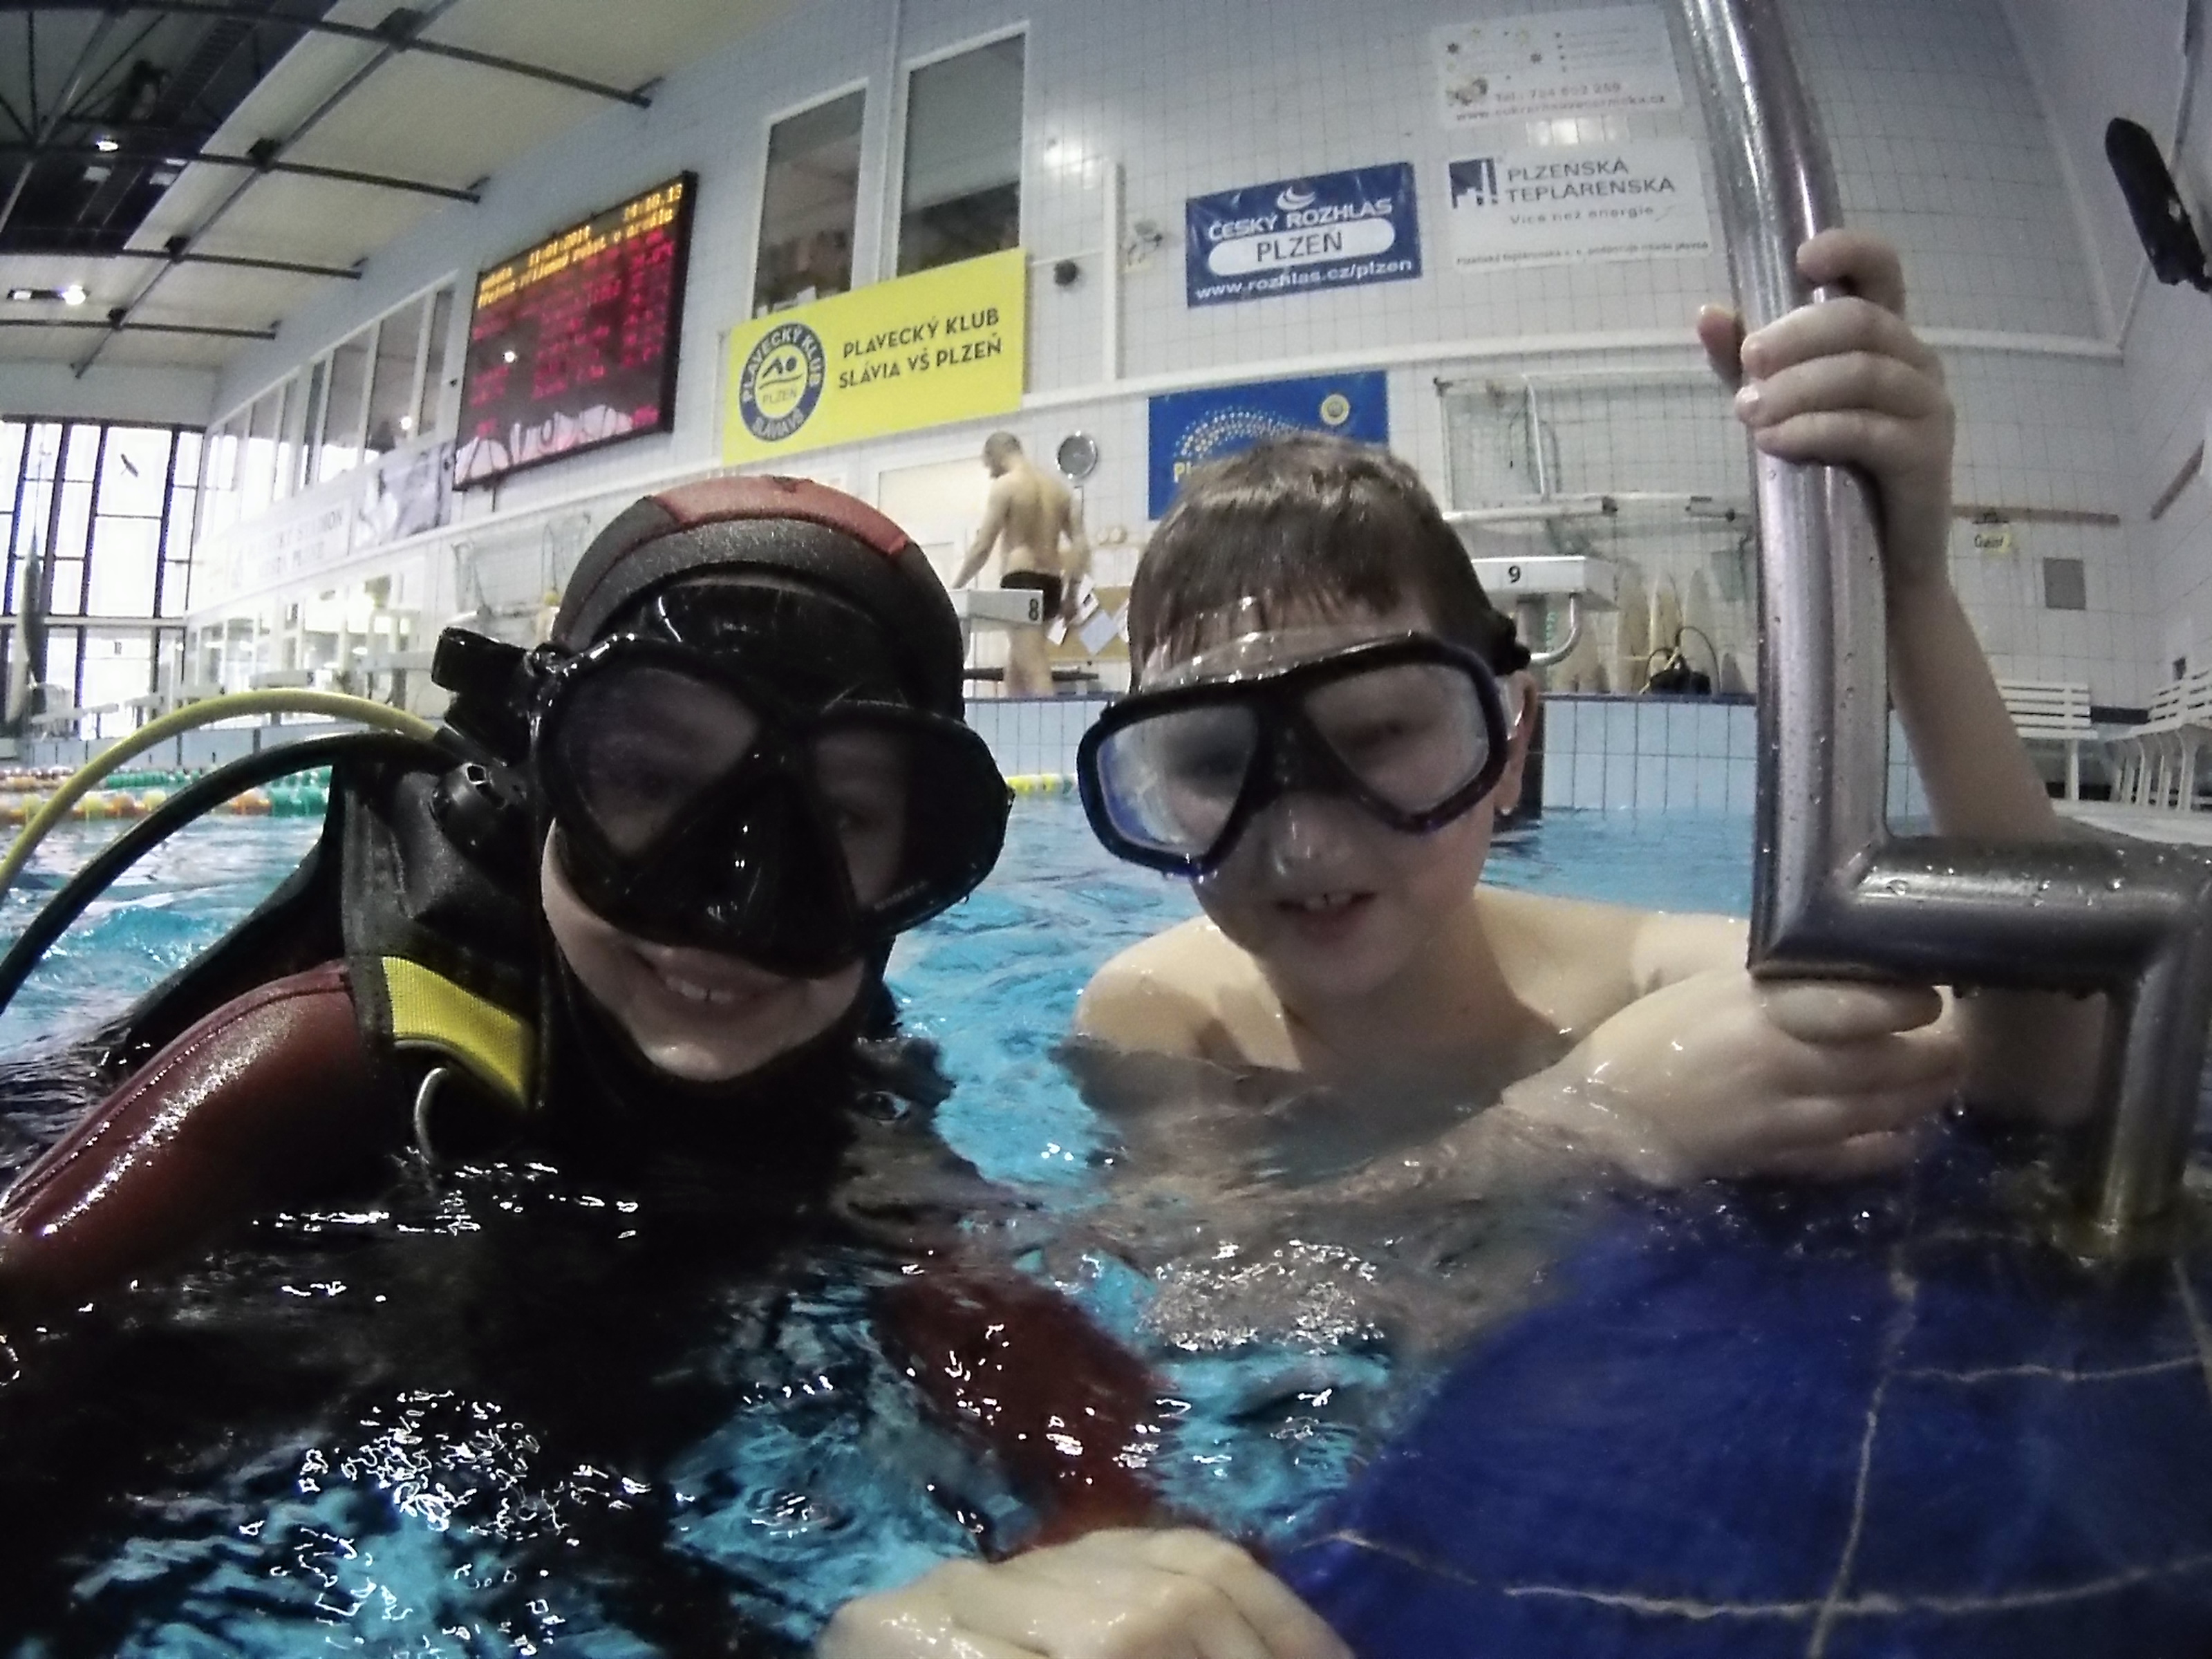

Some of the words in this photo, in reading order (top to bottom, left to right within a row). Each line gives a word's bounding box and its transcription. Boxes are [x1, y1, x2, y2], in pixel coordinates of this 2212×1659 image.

[1286, 197, 1393, 229] ROZHLAS
[843, 315, 939, 359] PLAVECKÝ
[946, 308, 1000, 335] KLUB
[1508, 565, 1521, 583] 9
[1028, 598, 1039, 621] 8
